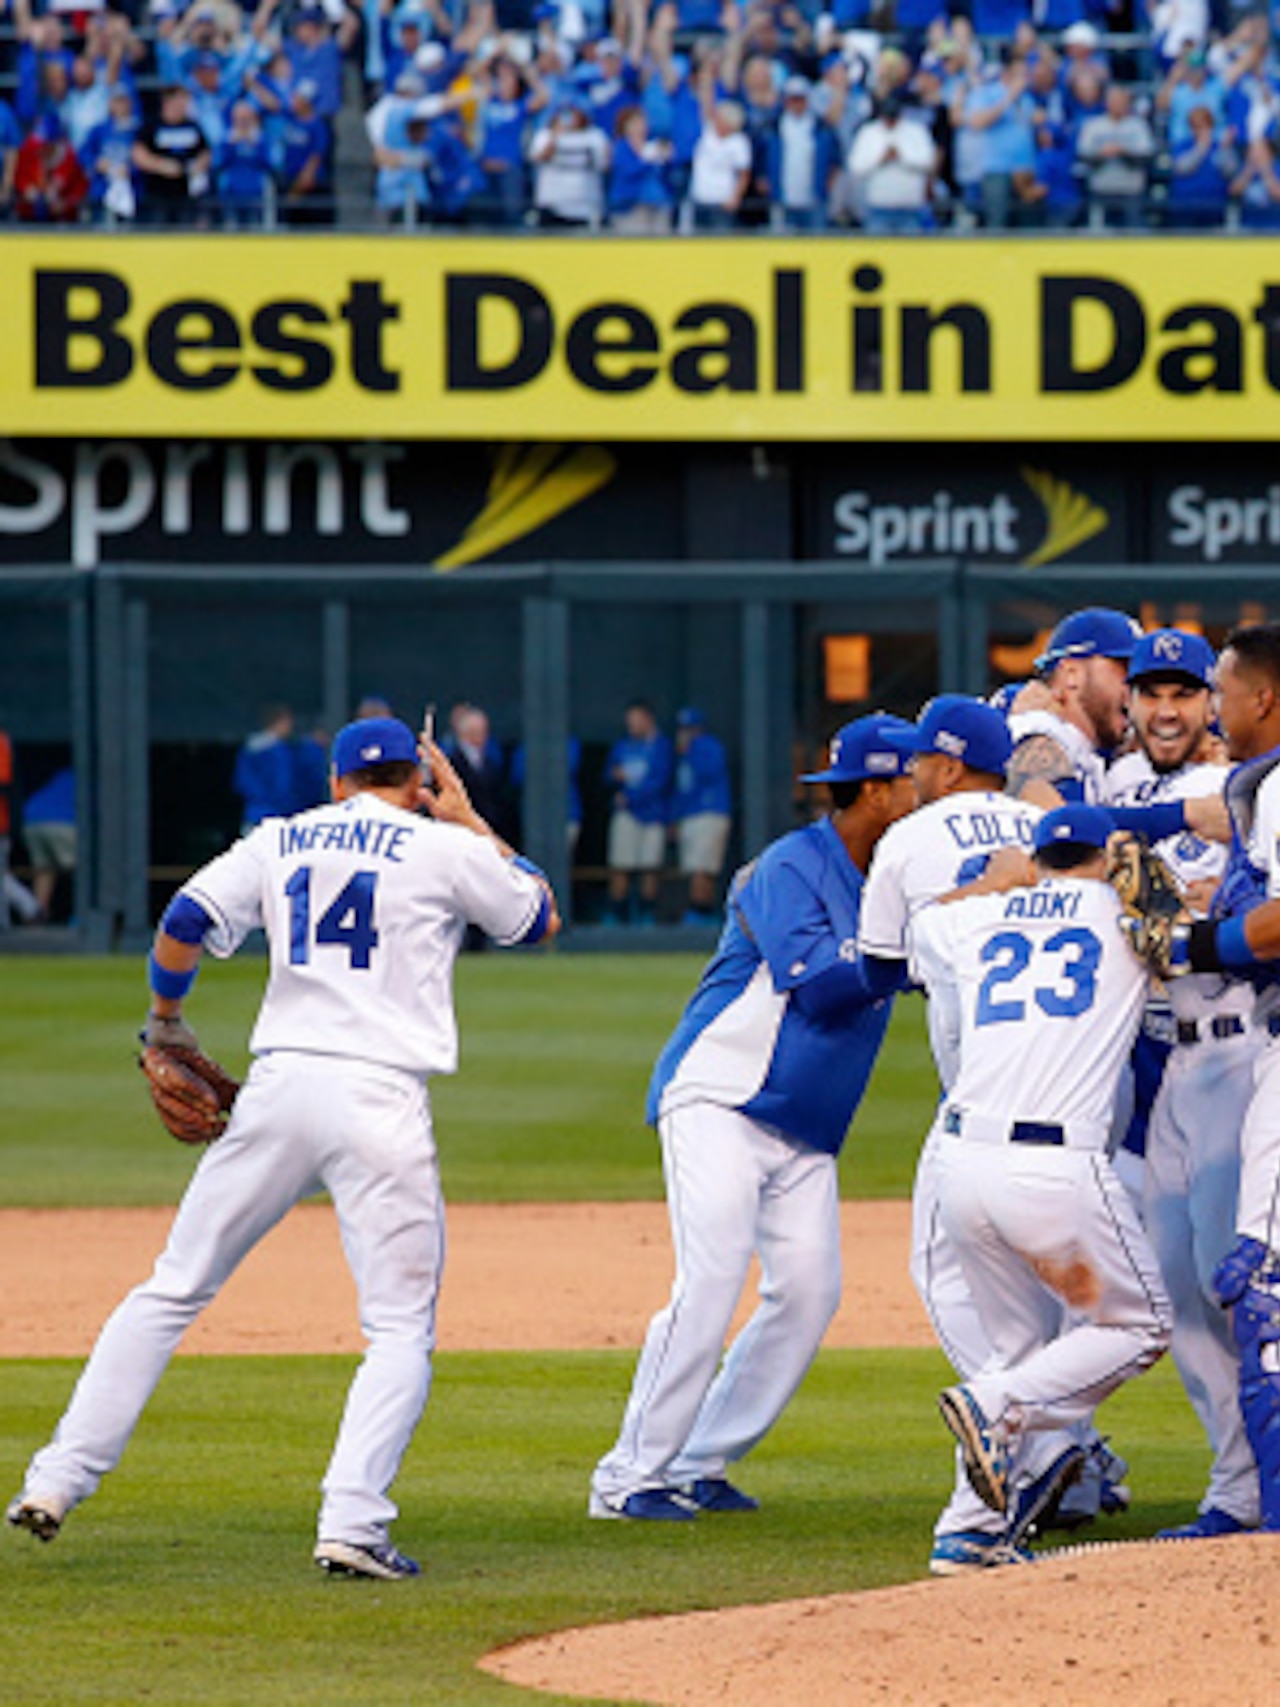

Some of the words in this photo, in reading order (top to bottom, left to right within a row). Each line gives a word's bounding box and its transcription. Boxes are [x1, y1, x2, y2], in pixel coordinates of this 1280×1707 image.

[32, 267, 402, 394] Best
[443, 266, 806, 394] Deal
[850, 263, 992, 395] in
[832, 491, 1018, 566] Sprint
[279, 821, 415, 863] INFANTE
[284, 866, 379, 970] 14
[1003, 891, 1083, 920] AOKI
[974, 926, 1104, 1028] 23
